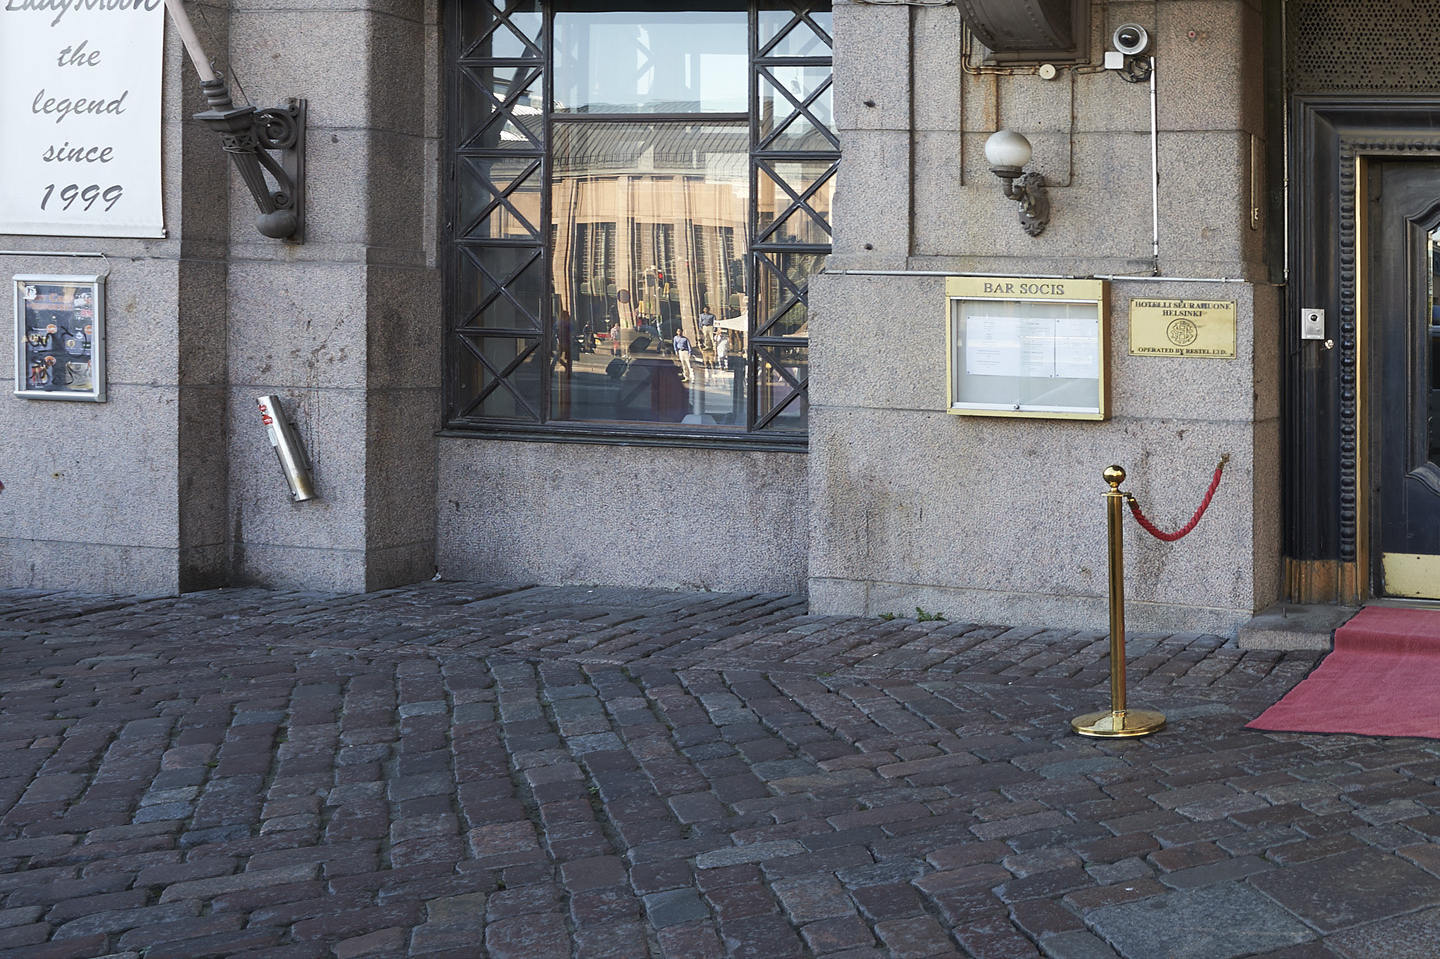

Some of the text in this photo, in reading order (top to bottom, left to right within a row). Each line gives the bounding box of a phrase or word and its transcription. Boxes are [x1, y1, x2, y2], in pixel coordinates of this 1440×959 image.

[57, 40, 102, 67] the
[32, 89, 128, 124] legend
[42, 142, 114, 164] since
[40, 184, 124, 211] 1999
[983, 282, 1065, 295] BAR SOCIS
[1135, 301, 1232, 310] HOTELLI SEURAHUONE
[1162, 309, 1203, 317] HELSINKI
